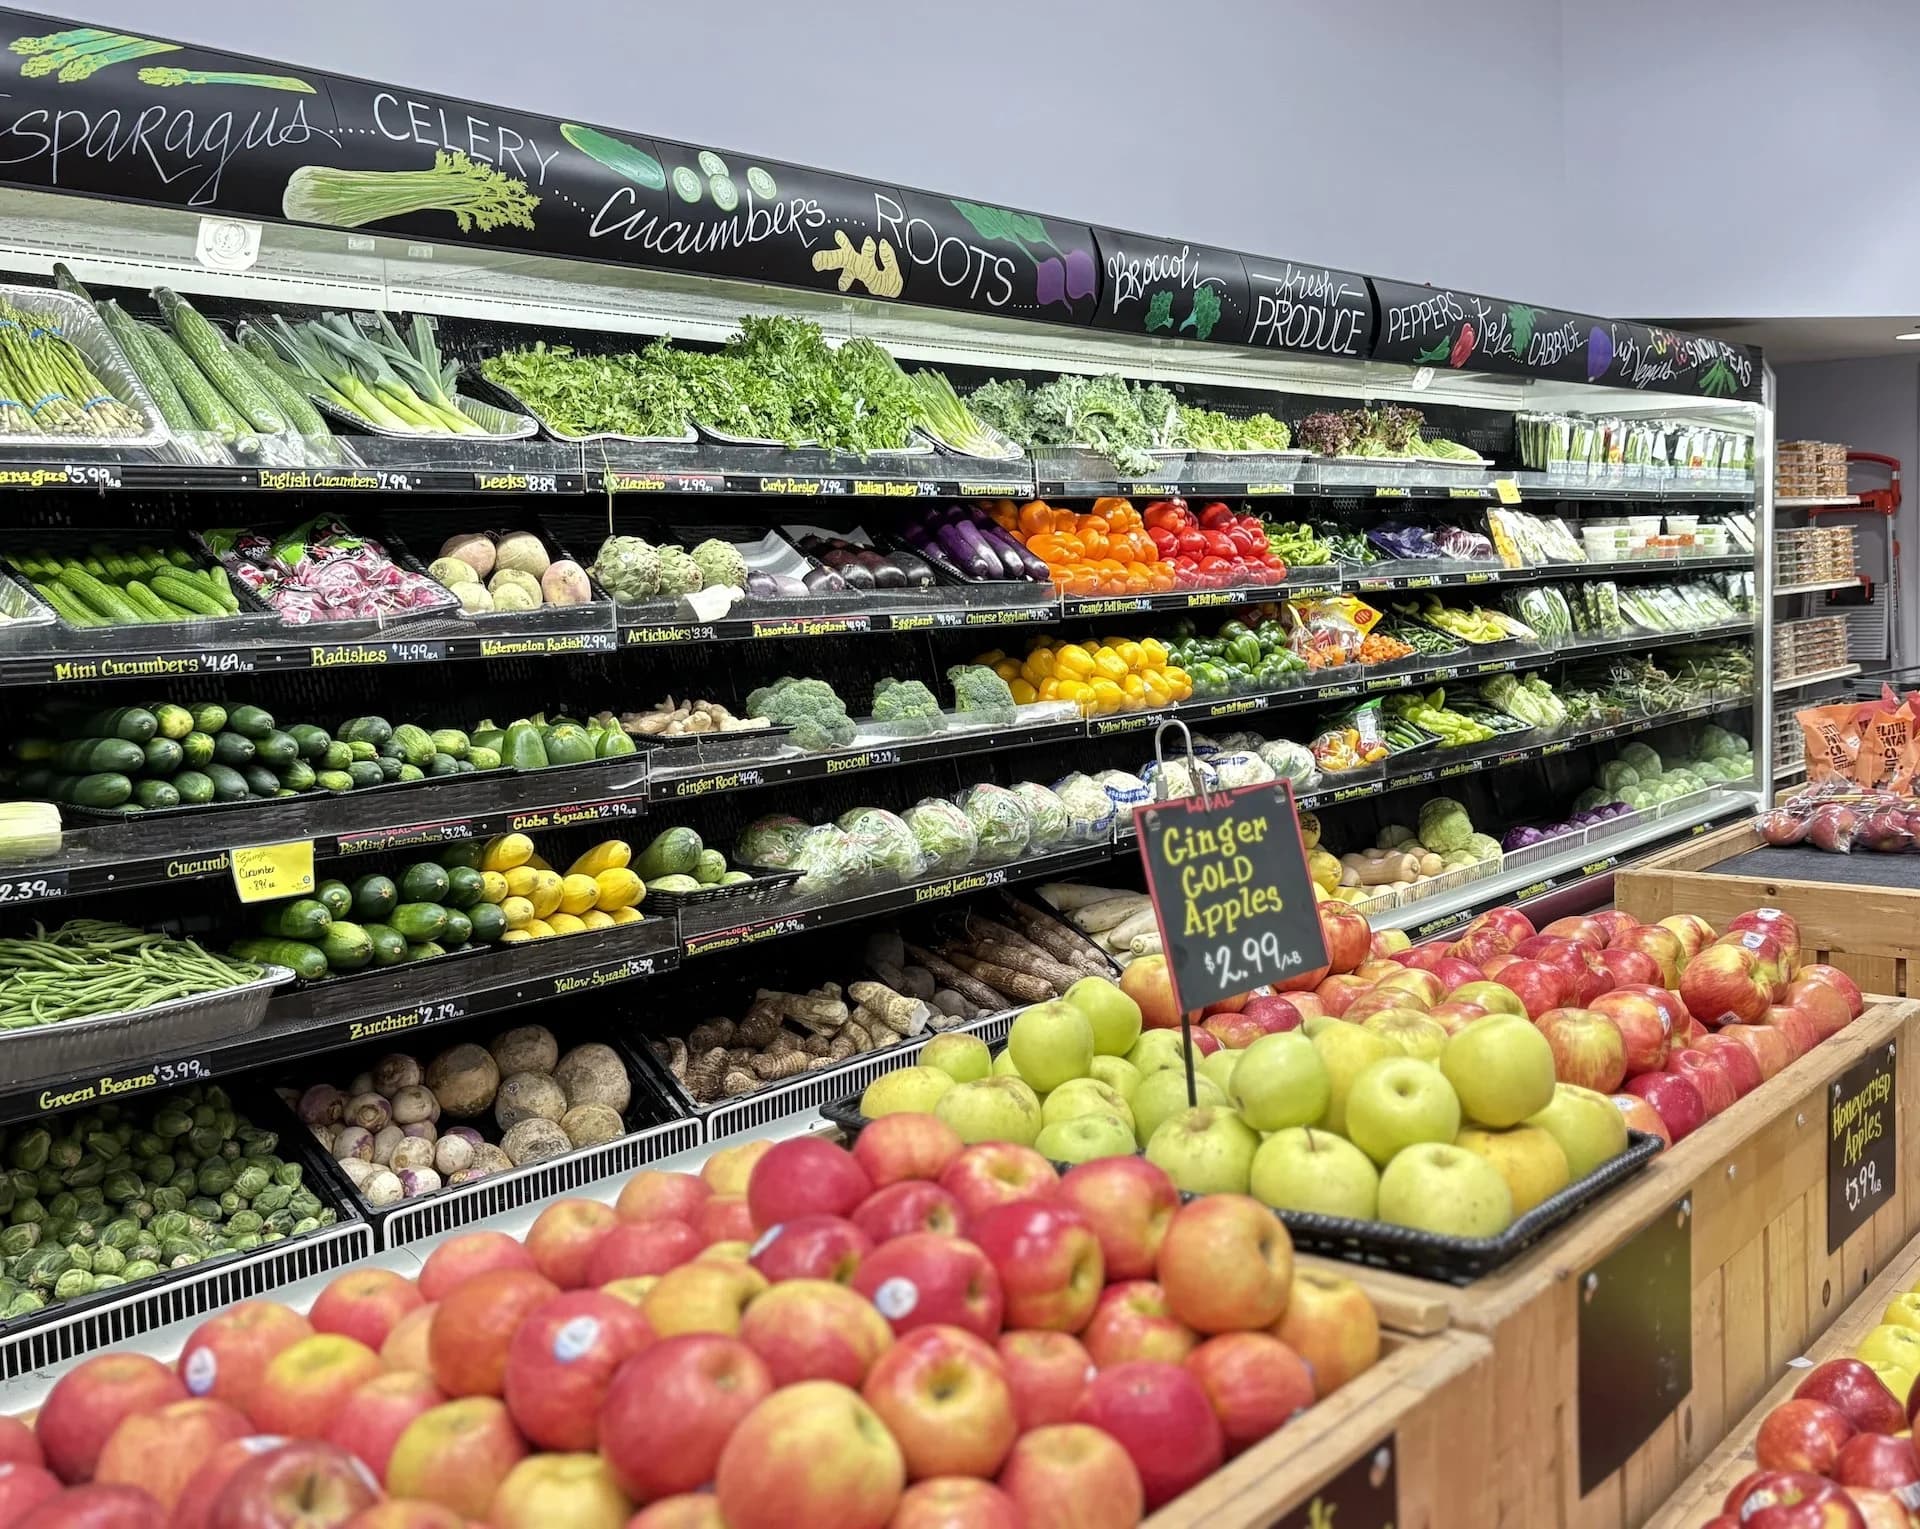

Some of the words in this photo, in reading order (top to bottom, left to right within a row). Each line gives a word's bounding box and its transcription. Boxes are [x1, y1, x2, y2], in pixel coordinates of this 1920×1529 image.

[0, 94, 342, 206] sparagus
[373, 92, 560, 186] CELERY
[874, 193, 1017, 307] ROOTS
[1249, 296, 1365, 354] PRODUCE
[1387, 291, 1465, 343] PEPPERS
[1470, 297, 1518, 358] Kale
[1528, 320, 1581, 367] CABBAGE
[1686, 338, 1718, 368] SNOW
[1718, 341, 1752, 387] PEAS
[259, 471, 310, 489] English
[313, 472, 378, 488] Cucumbers
[479, 474, 526, 489] Leeks
[761, 478, 786, 493] Curly
[787, 479, 819, 496] Parsley
[854, 481, 884, 496] Italian
[885, 481, 918, 496] Parsley
[1079, 603, 1103, 614] Orange
[1104, 602, 1117, 613] Bell
[1117, 601, 1136, 613] Peppers
[1188, 595, 1199, 606] Red
[1211, 593, 1230, 606] Peppers
[753, 622, 799, 637] Assorted
[802, 619, 846, 635] Eggplant
[892, 615, 934, 629] Eggplant
[965, 611, 997, 624] Chinese
[998, 609, 1029, 627] Eggplant
[482, 641, 545, 656] Watermelon
[547, 636, 583, 651] Radish
[627, 625, 691, 643] Artichokes
[54, 661, 97, 680] Mini
[101, 656, 199, 676] Cucumbers
[311, 645, 388, 667] Radishes
[1097, 722, 1120, 734] Yellow
[1120, 718, 1146, 732] Peppers
[826, 753, 869, 773] Broccoli
[676, 780, 715, 796] Ginger
[715, 774, 739, 790] Root
[513, 814, 549, 830] Globe
[553, 810, 600, 826] Squash
[338, 838, 386, 855] Pickling
[387, 832, 443, 848] Cucumbers
[1163, 816, 1267, 866] Ginger
[167, 853, 230, 878] Cucumb
[1182, 856, 1254, 899] GOLD
[915, 880, 952, 902] Iceberg
[952, 875, 987, 893] Lettuce
[1184, 886, 1283, 938] Apples
[687, 937, 740, 957] Romanesco
[742, 924, 777, 944] Squash
[726, 924, 753, 935] LOCAL
[554, 977, 590, 994] Yellow
[591, 963, 631, 986] Squash
[350, 1010, 418, 1040] Zucchini
[40, 1086, 96, 1110] Green
[99, 1073, 157, 1096] Beans
[1833, 1069, 1891, 1141] Honeycrisp
[1843, 1110, 1882, 1167] Apples
